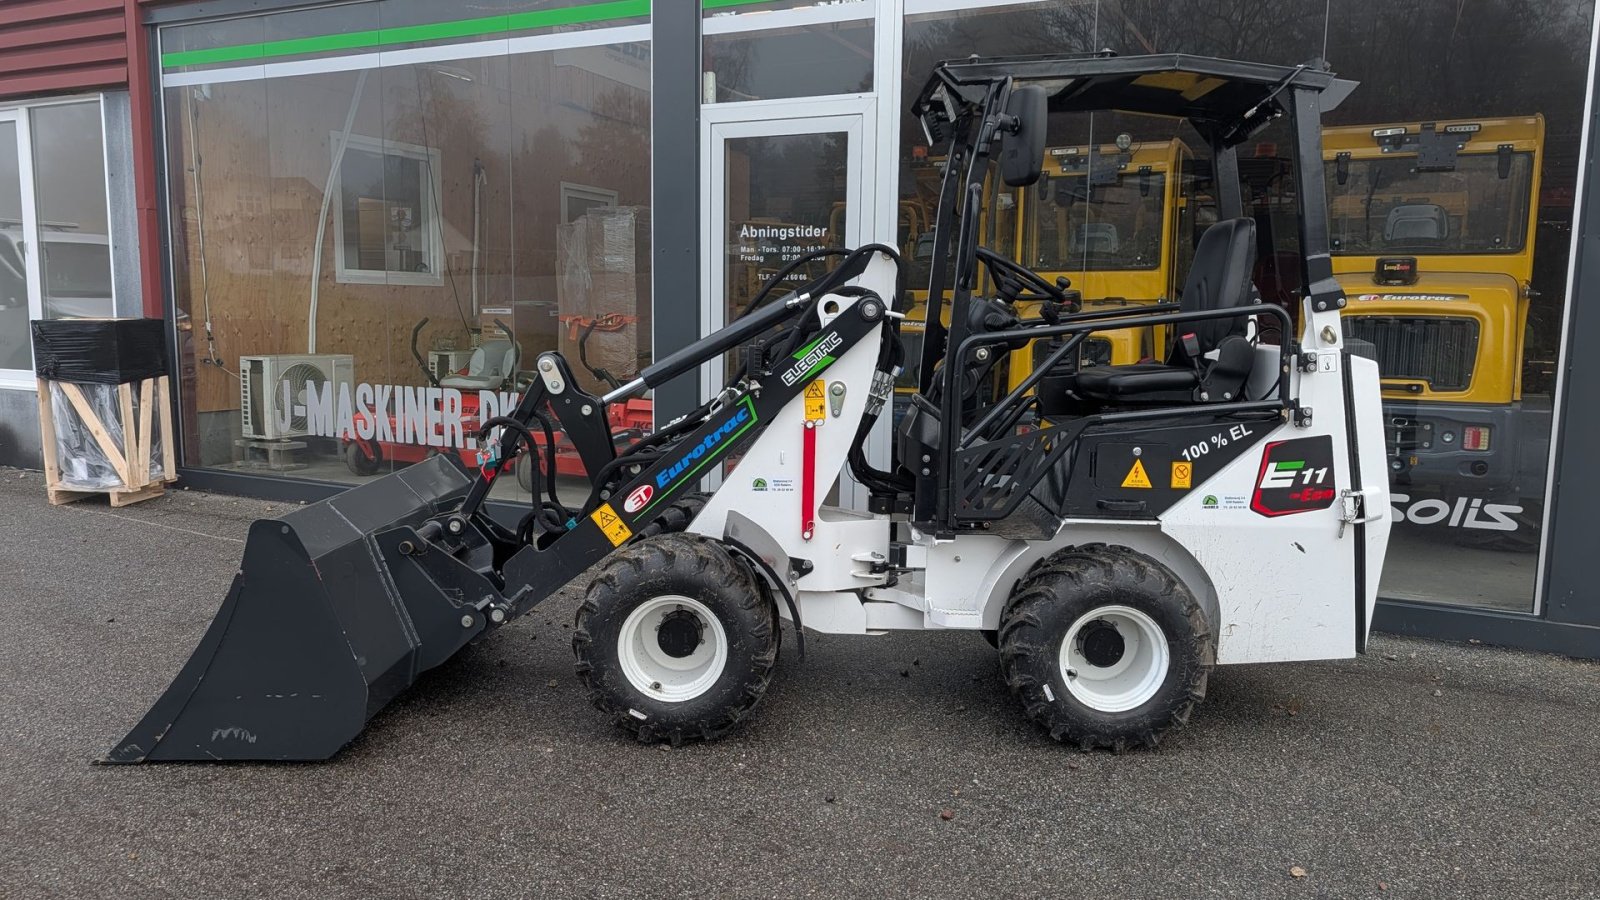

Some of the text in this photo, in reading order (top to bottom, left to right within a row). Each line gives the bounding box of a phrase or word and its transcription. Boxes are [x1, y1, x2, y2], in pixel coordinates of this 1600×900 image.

[781, 331, 842, 386] ELECTRIC
[656, 407, 750, 489] Eurotrac
[1182, 423, 1254, 462] 100 % EL
[630, 488, 653, 509] ET
